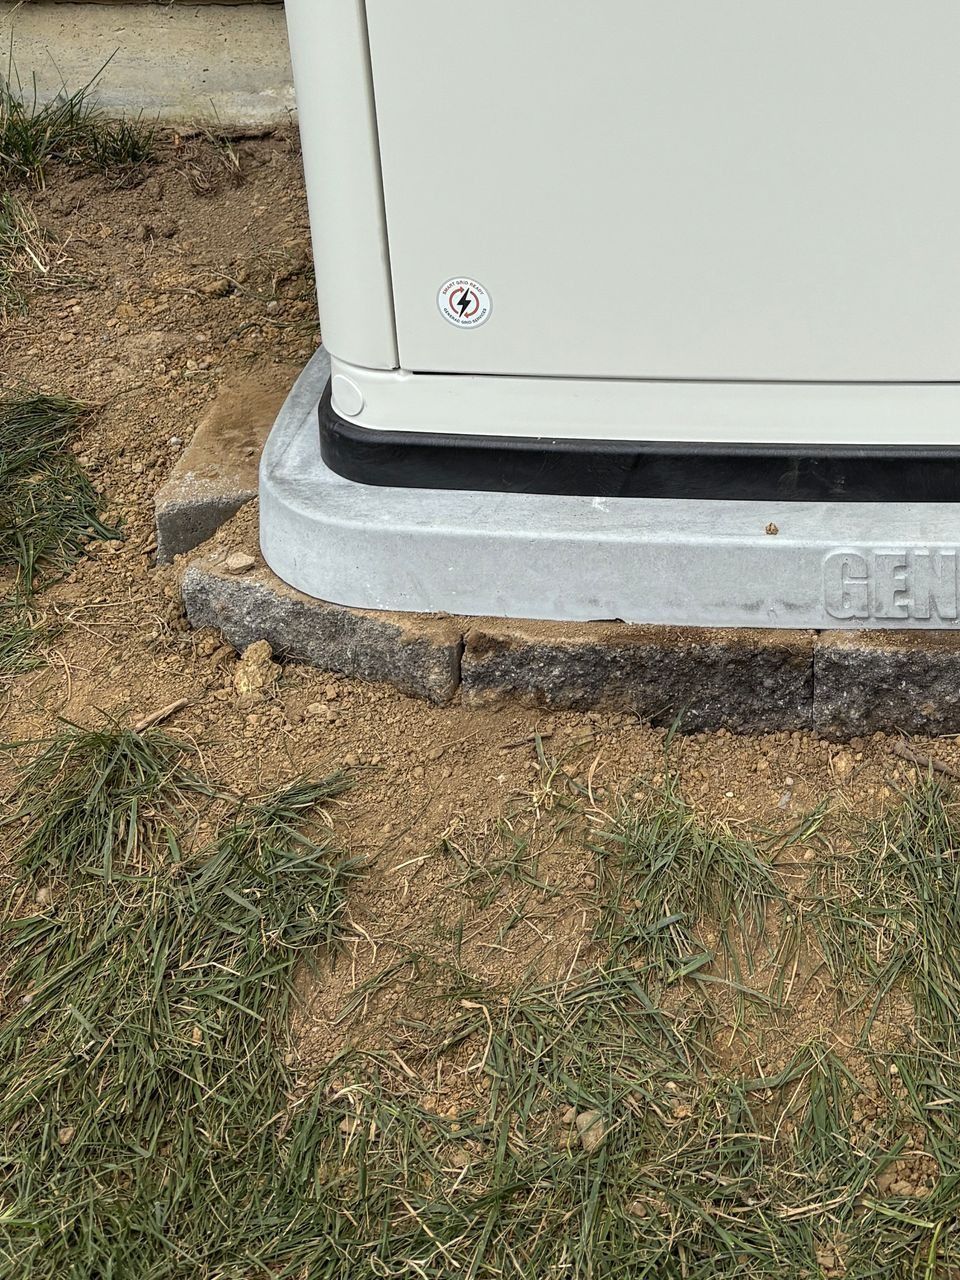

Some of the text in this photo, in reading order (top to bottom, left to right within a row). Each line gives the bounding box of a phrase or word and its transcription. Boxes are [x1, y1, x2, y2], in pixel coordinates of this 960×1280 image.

[442, 282, 456, 295] SMART
[470, 282, 484, 295] READY
[444, 308, 460, 323] GENERAC
[472, 308, 487, 323] SERVICES
